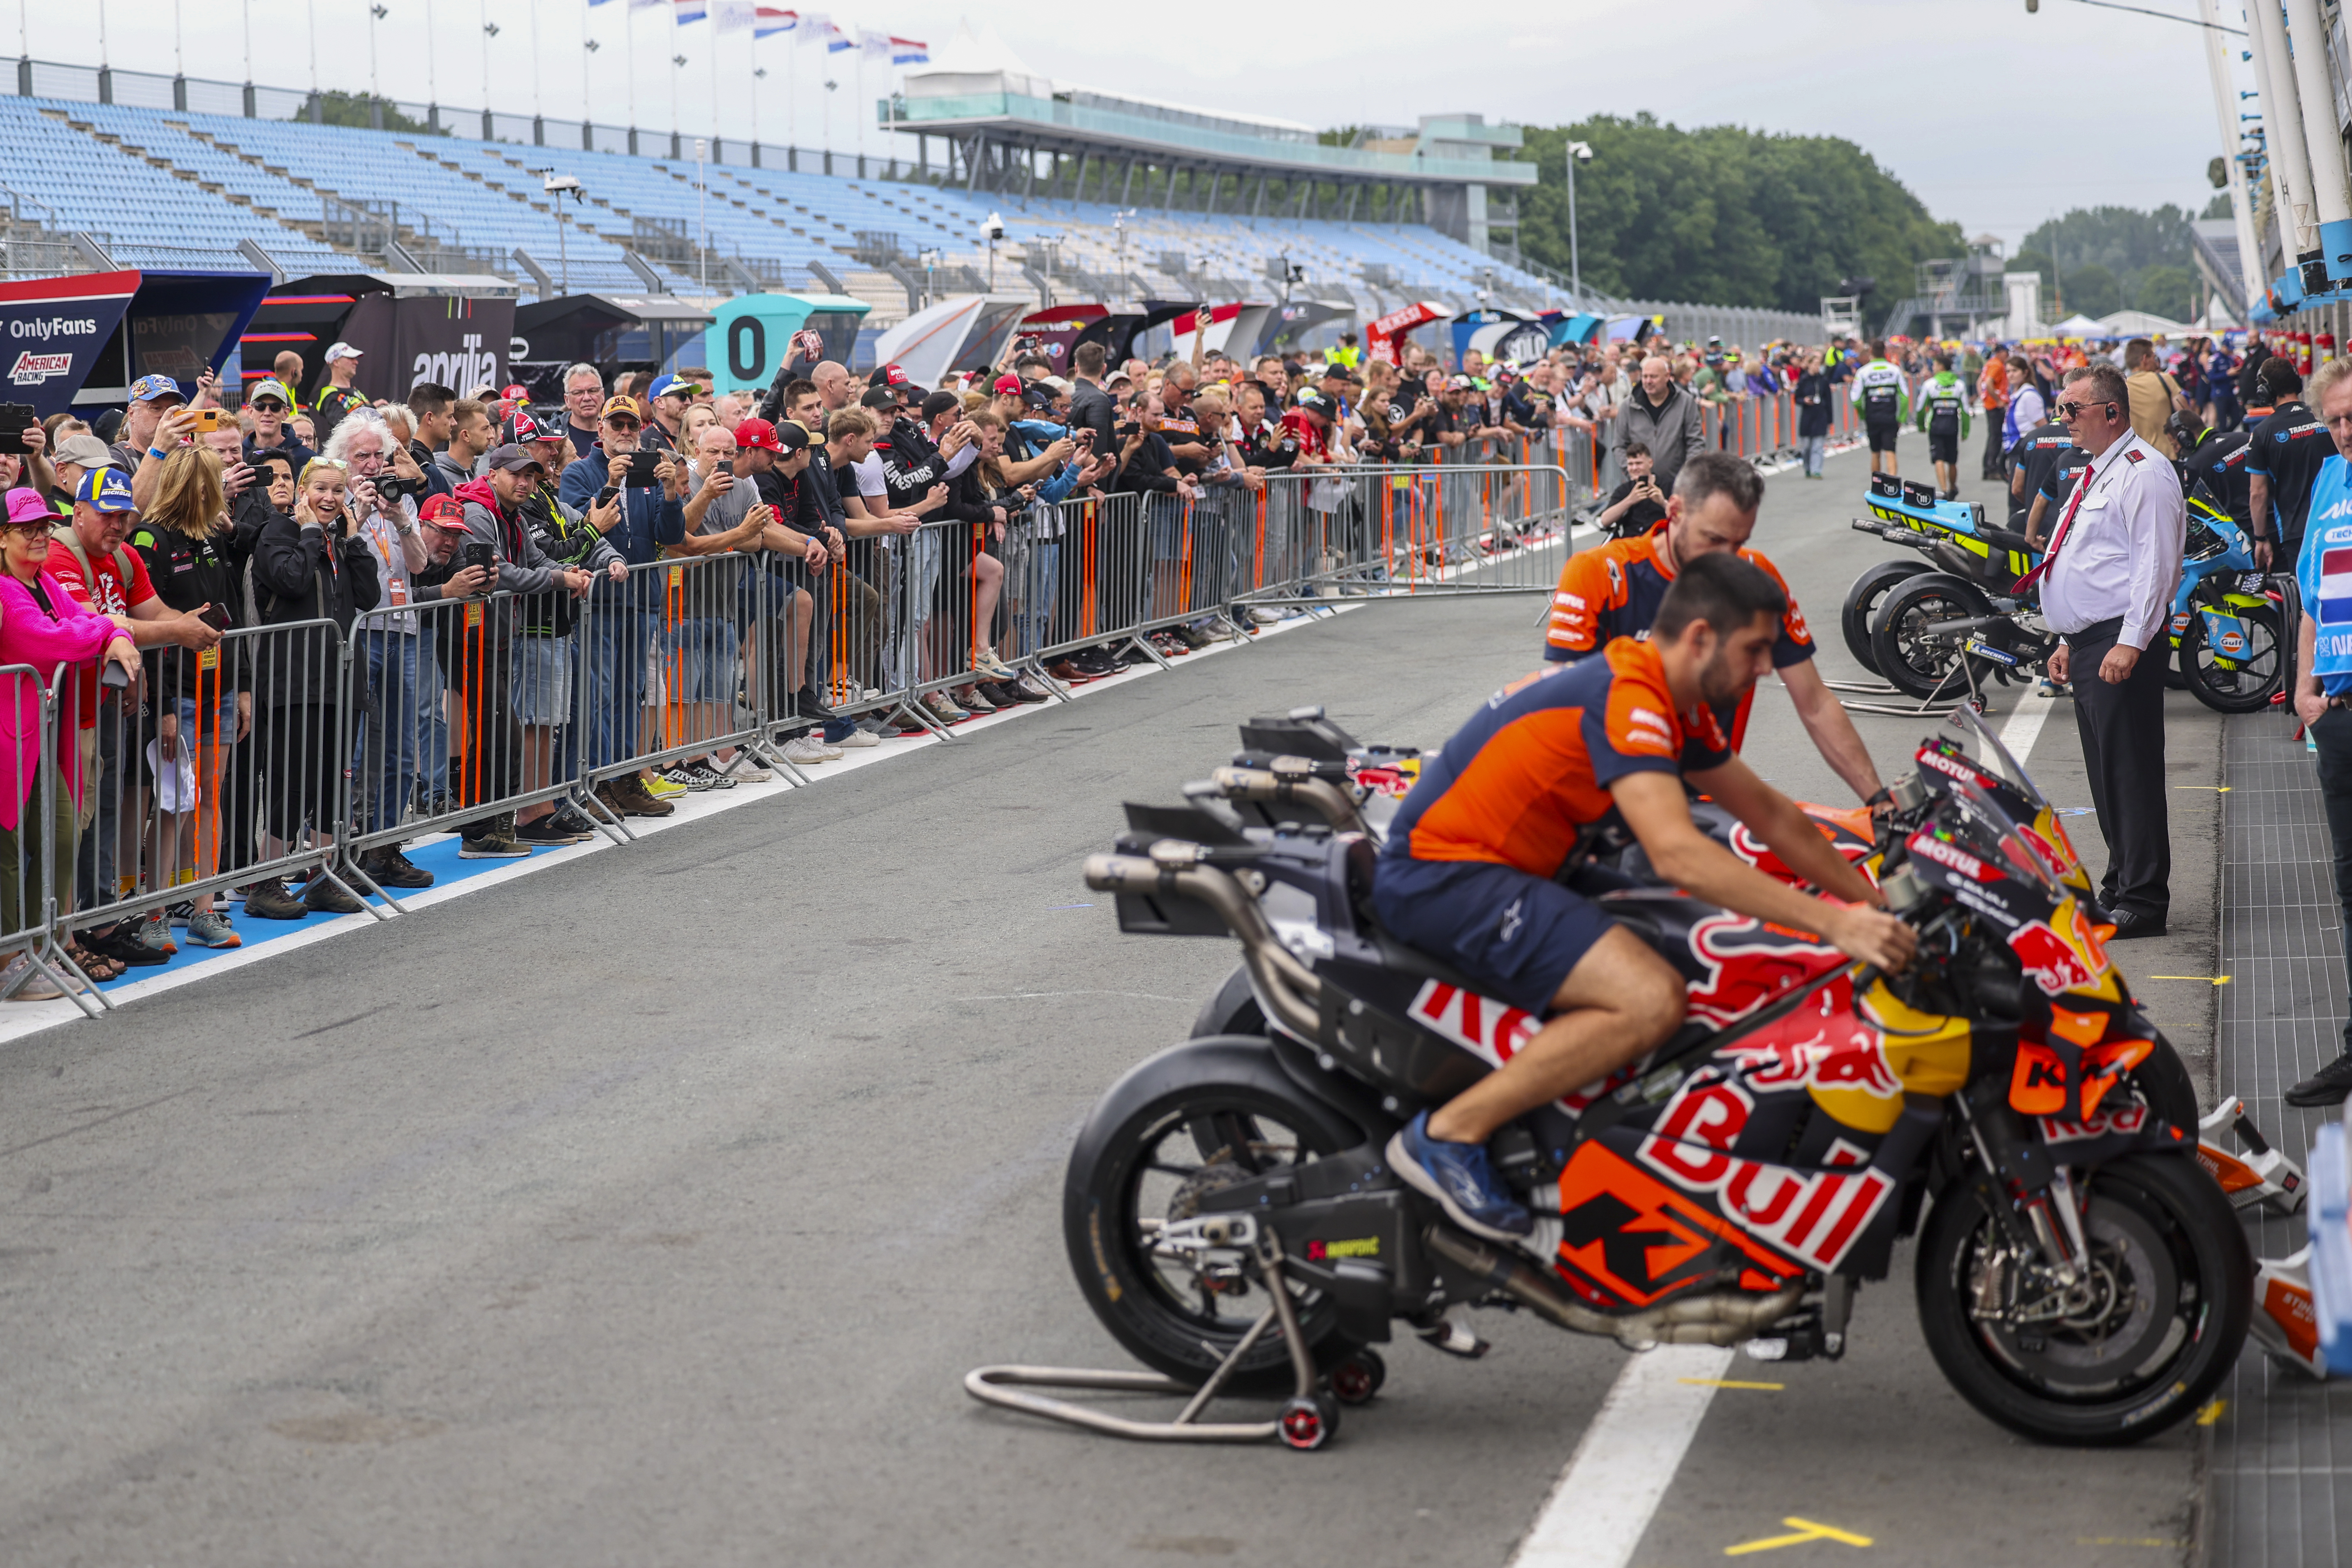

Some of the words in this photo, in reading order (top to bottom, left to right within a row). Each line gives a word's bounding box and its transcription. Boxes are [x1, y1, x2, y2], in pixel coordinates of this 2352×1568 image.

[10, 317, 97, 341] OnlyFans
[14, 353, 69, 375] AMERICAN
[411, 334, 496, 400] aprilia
[17, 371, 44, 382] RACING
[174, 563, 193, 573] SHOWA
[2221, 638, 2243, 646] Gulf
[1980, 649, 2013, 663] MICHELIN
[1919, 750, 1977, 781] MOTUL
[1912, 834, 1982, 878] MOTUL
[1639, 1066, 1891, 1271] Bull
